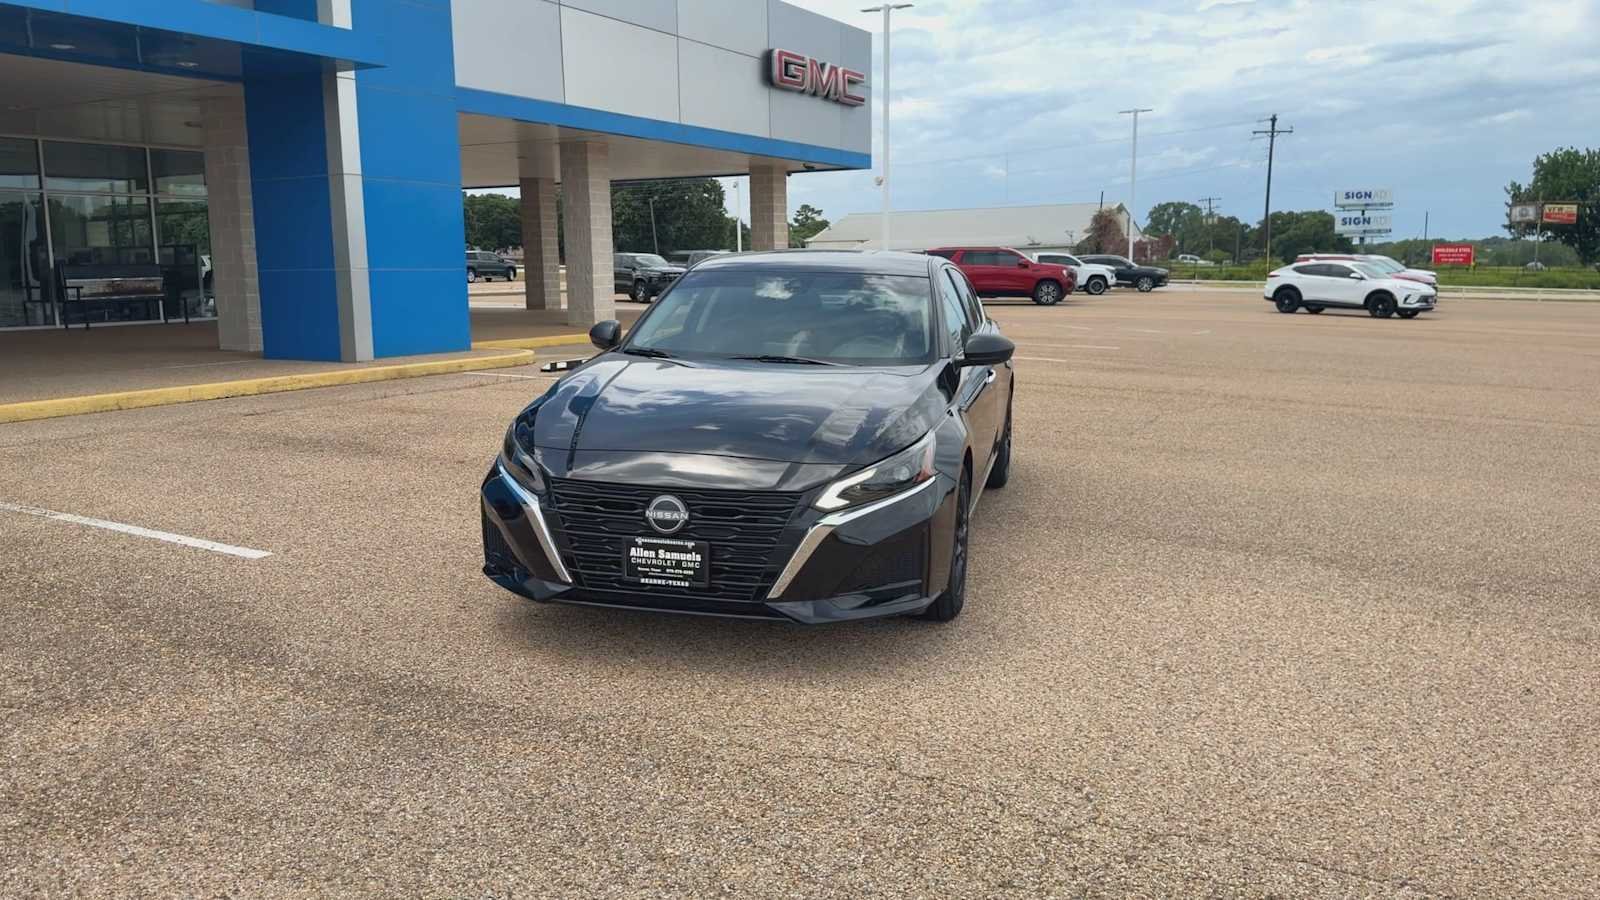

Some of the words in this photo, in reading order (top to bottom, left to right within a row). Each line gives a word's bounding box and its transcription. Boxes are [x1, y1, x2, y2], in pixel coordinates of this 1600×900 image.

[772, 48, 865, 106] GMC
[645, 510, 689, 520] NISSAN
[629, 546, 656, 558] Allen
[658, 549, 702, 562] Samuels
[631, 557, 677, 567] CHEVROLET
[681, 561, 701, 569] GMC
